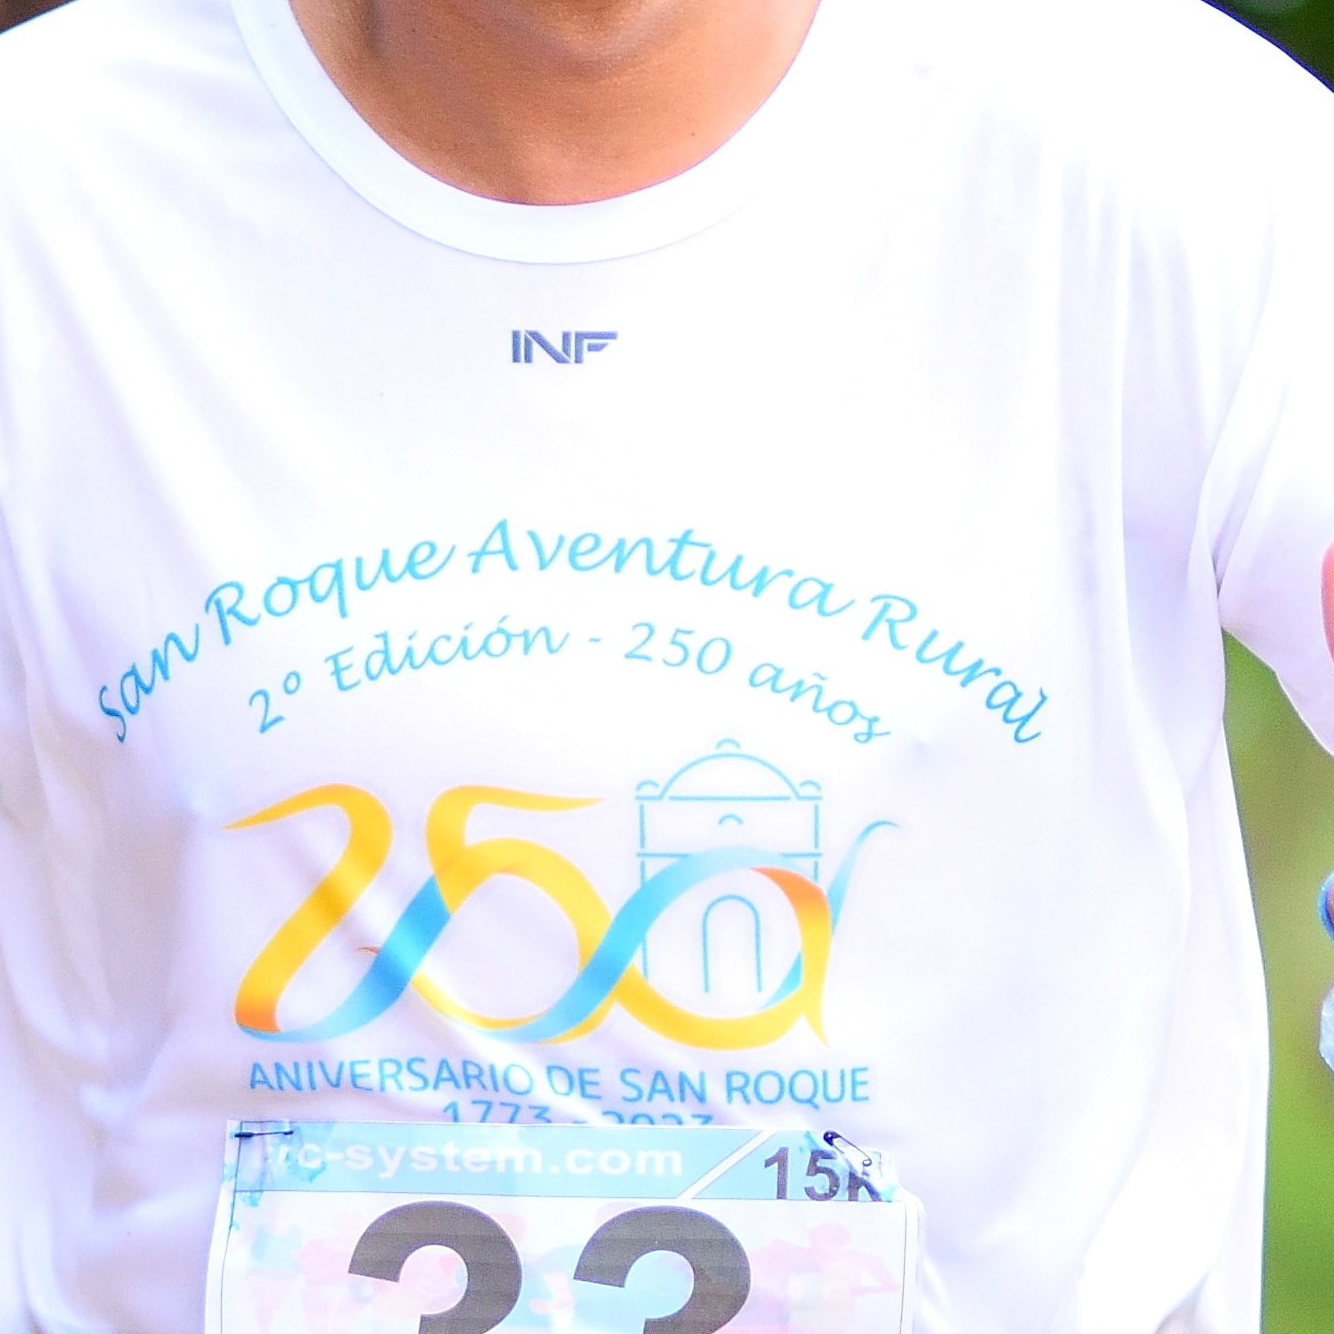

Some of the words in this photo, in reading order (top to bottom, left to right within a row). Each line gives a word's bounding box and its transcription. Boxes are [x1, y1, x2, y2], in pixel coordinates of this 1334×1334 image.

[511, 329, 618, 364] INF
[99, 624, 201, 743] San
[204, 539, 457, 645] Roque
[466, 518, 856, 617] Aventura
[861, 594, 1048, 744] Rural
[323, 615, 570, 692] Edición
[623, 621, 733, 675] 250
[747, 662, 891, 744] años
[248, 1056, 535, 1097] ANIVERSARIO
[546, 1065, 604, 1101] DE
[619, 1066, 708, 1105] SAN
[724, 1066, 870, 1110] ROQUE
